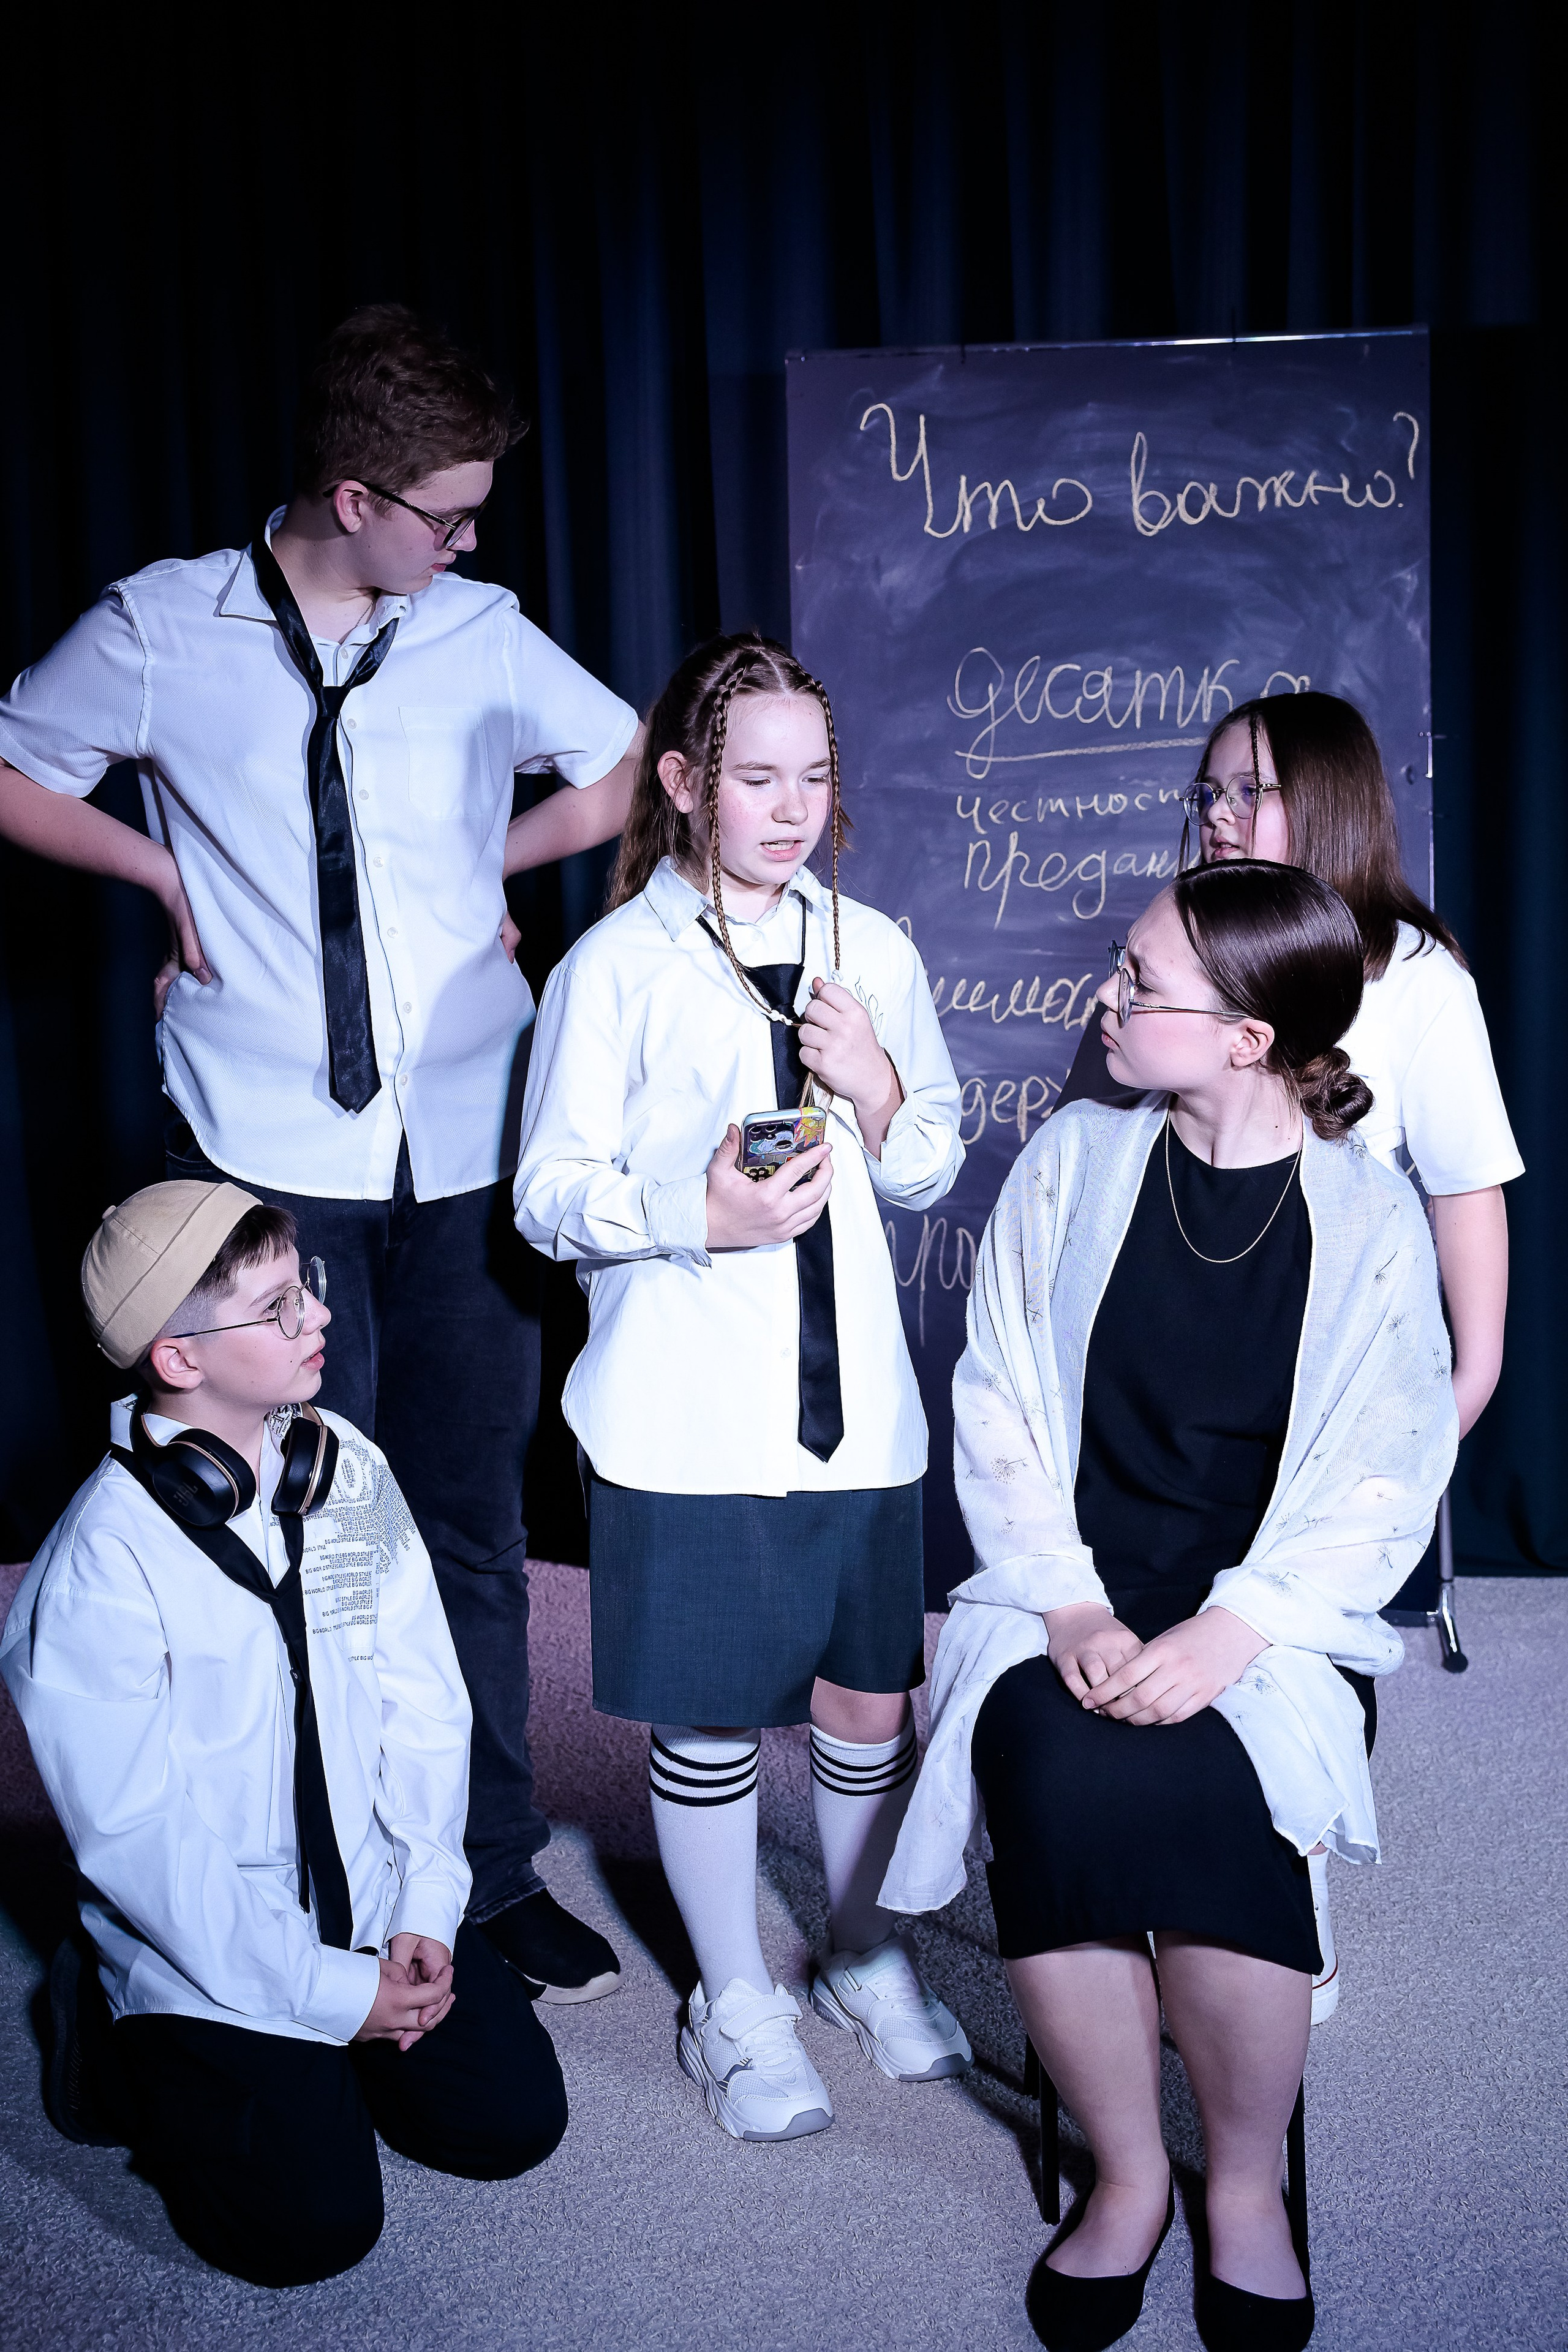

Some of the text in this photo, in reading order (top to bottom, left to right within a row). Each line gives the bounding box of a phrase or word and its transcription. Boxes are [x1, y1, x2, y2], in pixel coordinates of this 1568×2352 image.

[860, 403, 1419, 538] Что важно?
[175, 1481, 198, 1507] JBL
